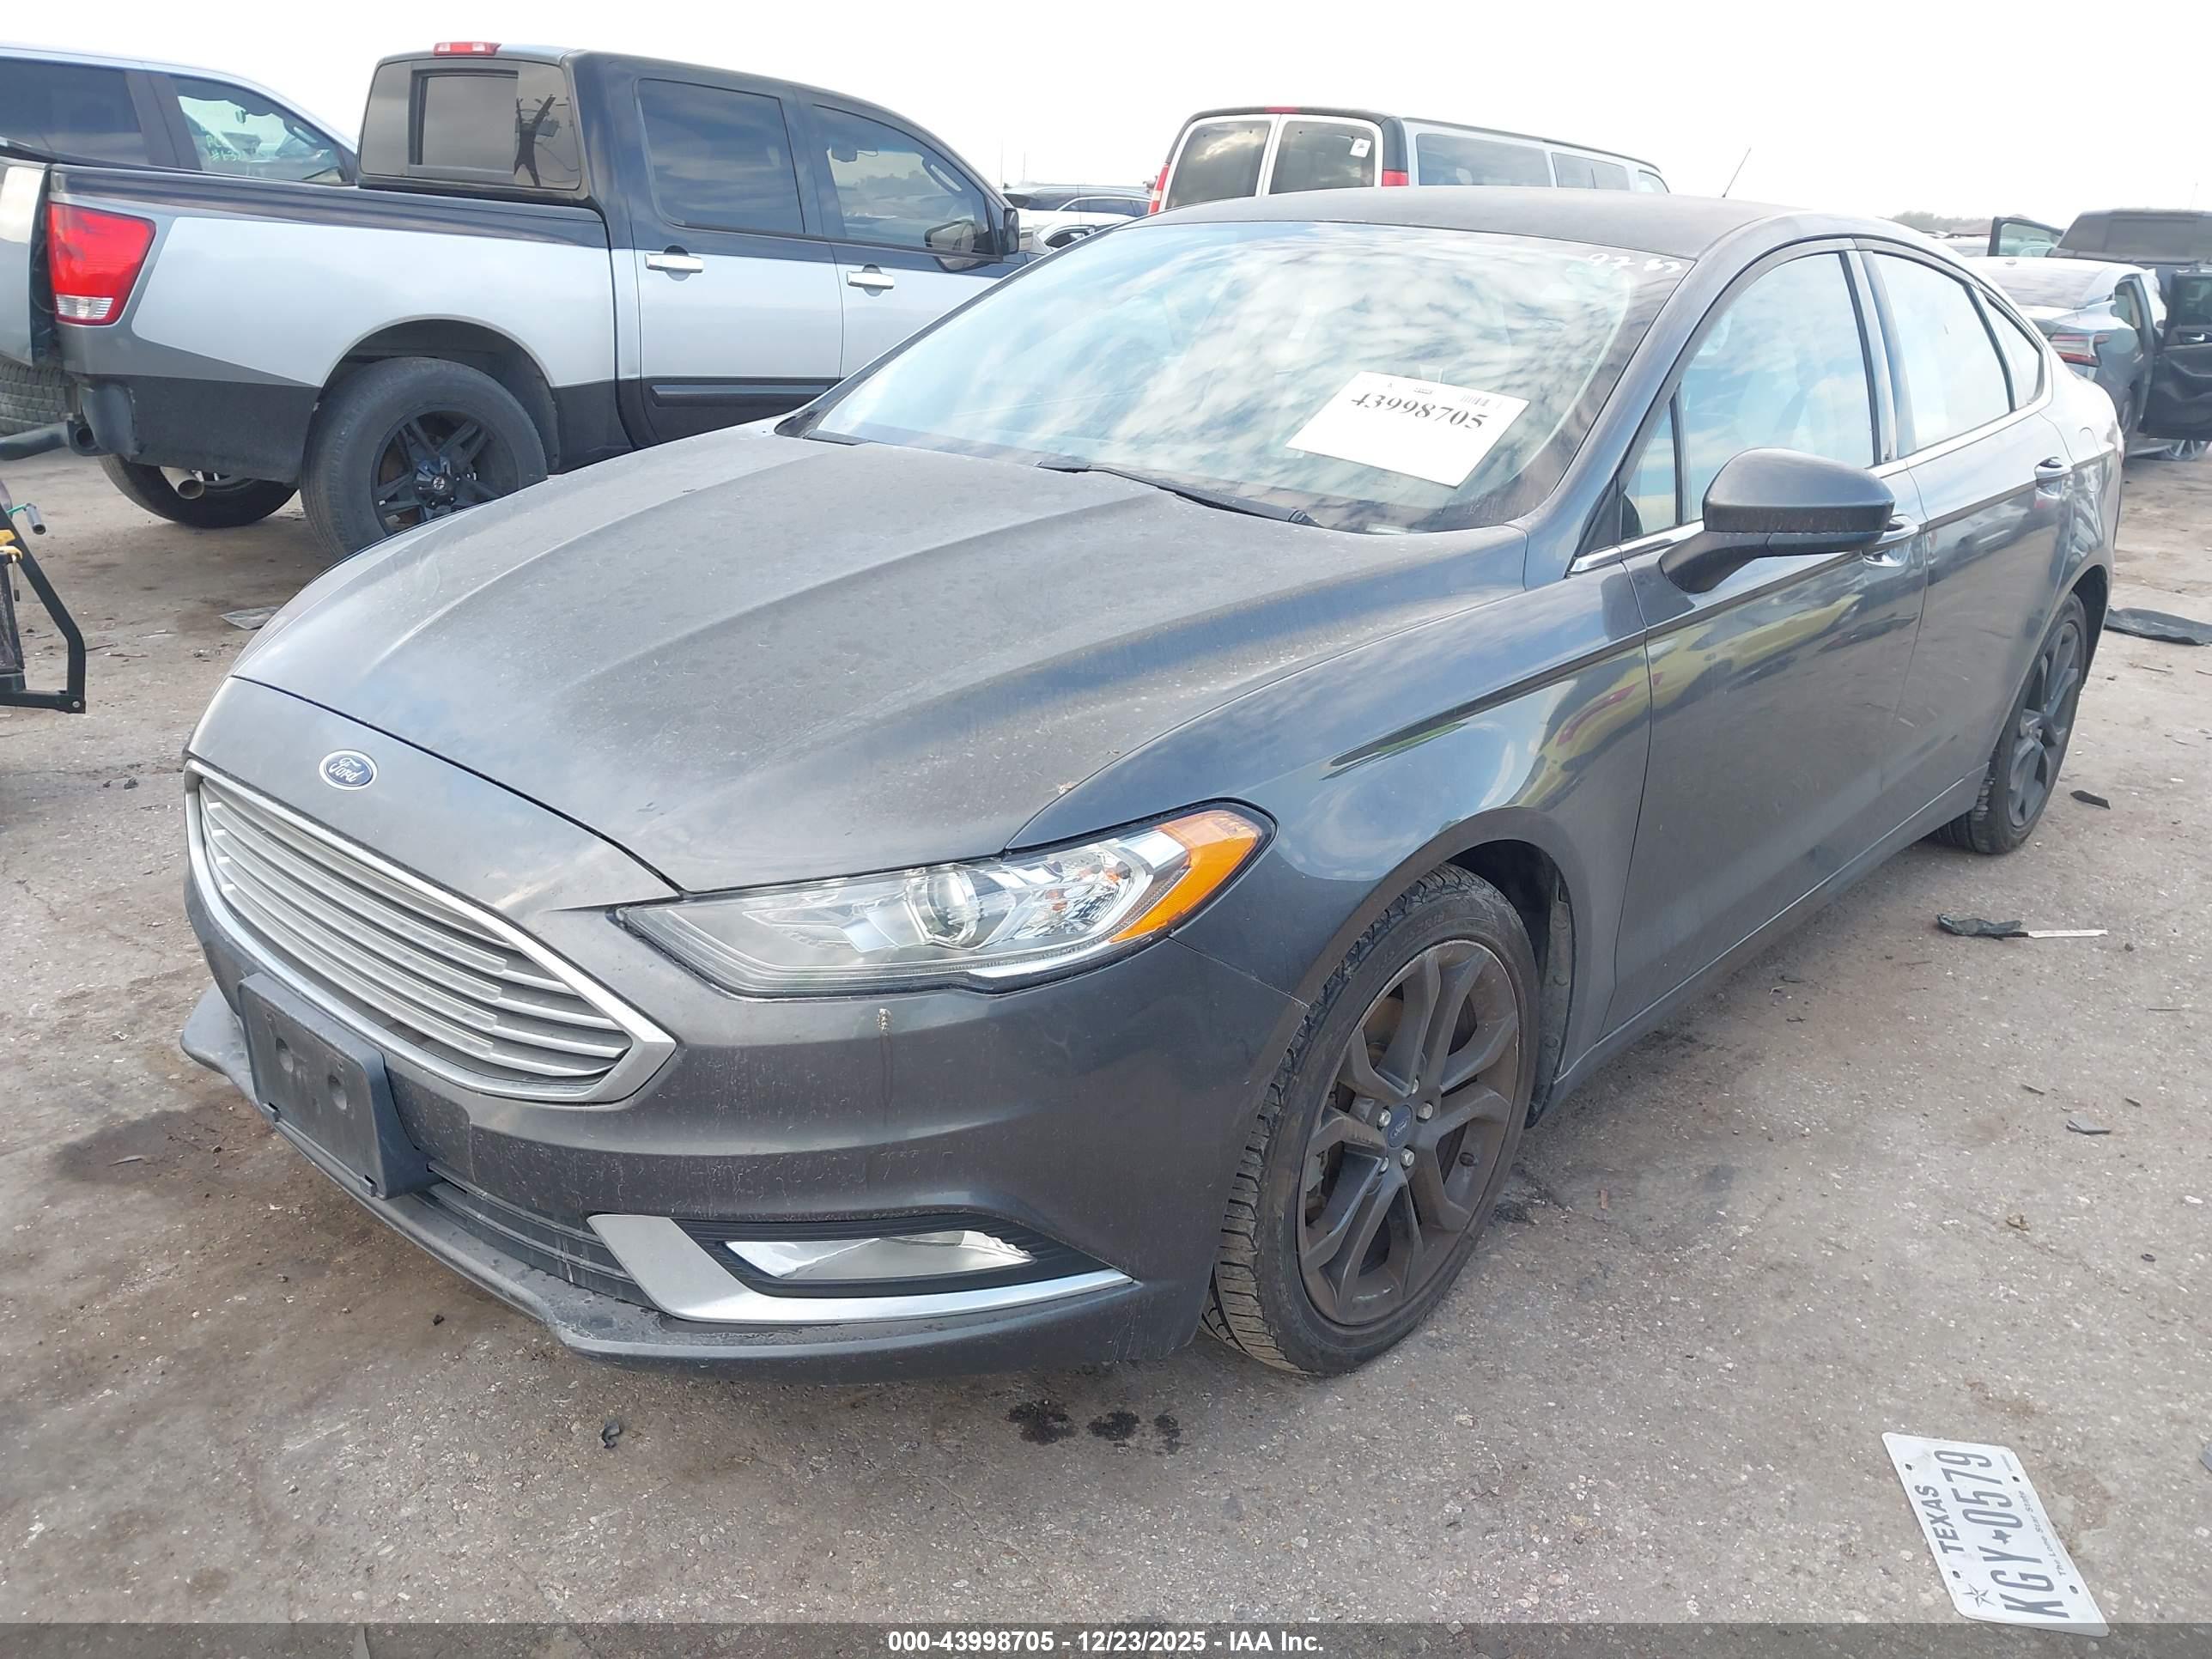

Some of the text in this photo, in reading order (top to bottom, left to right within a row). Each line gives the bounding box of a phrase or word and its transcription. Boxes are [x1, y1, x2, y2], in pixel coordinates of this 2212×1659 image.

[1351, 392, 1489, 429] 43998705
[328, 757, 365, 783] Ford
[1913, 1484, 1966, 1554] TEXAS
